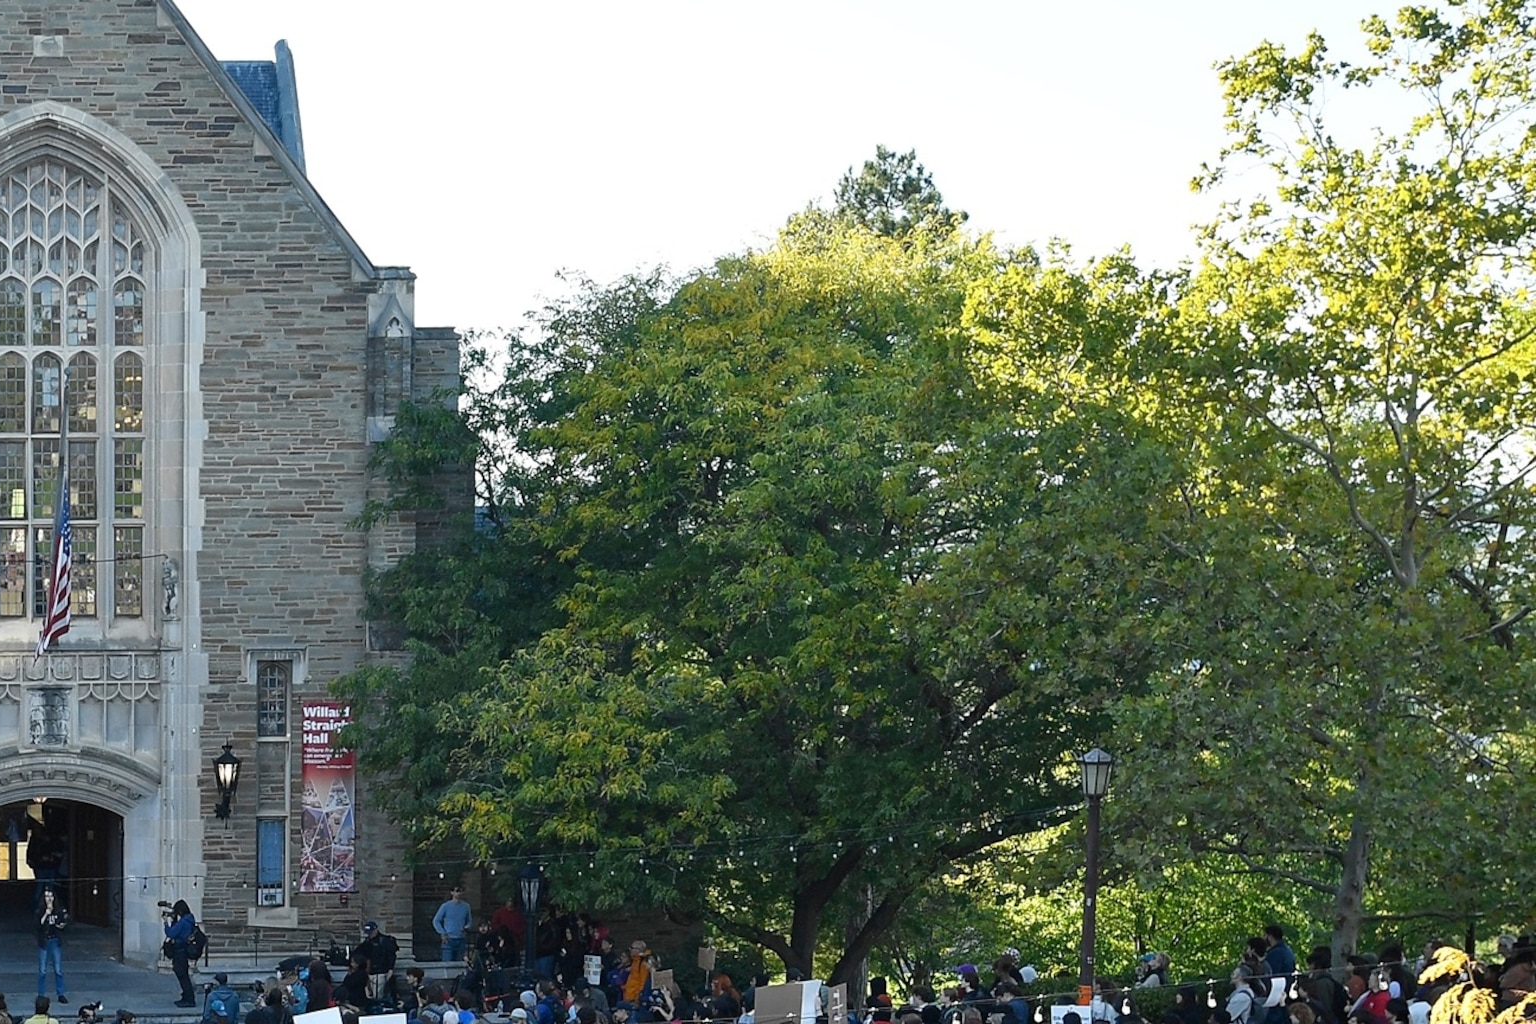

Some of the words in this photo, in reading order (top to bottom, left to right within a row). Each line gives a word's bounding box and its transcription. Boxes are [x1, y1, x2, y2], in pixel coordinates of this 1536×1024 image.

[303, 706, 350, 717] Willad
[303, 719, 354, 734] Straig
[303, 733, 328, 744] Hall
